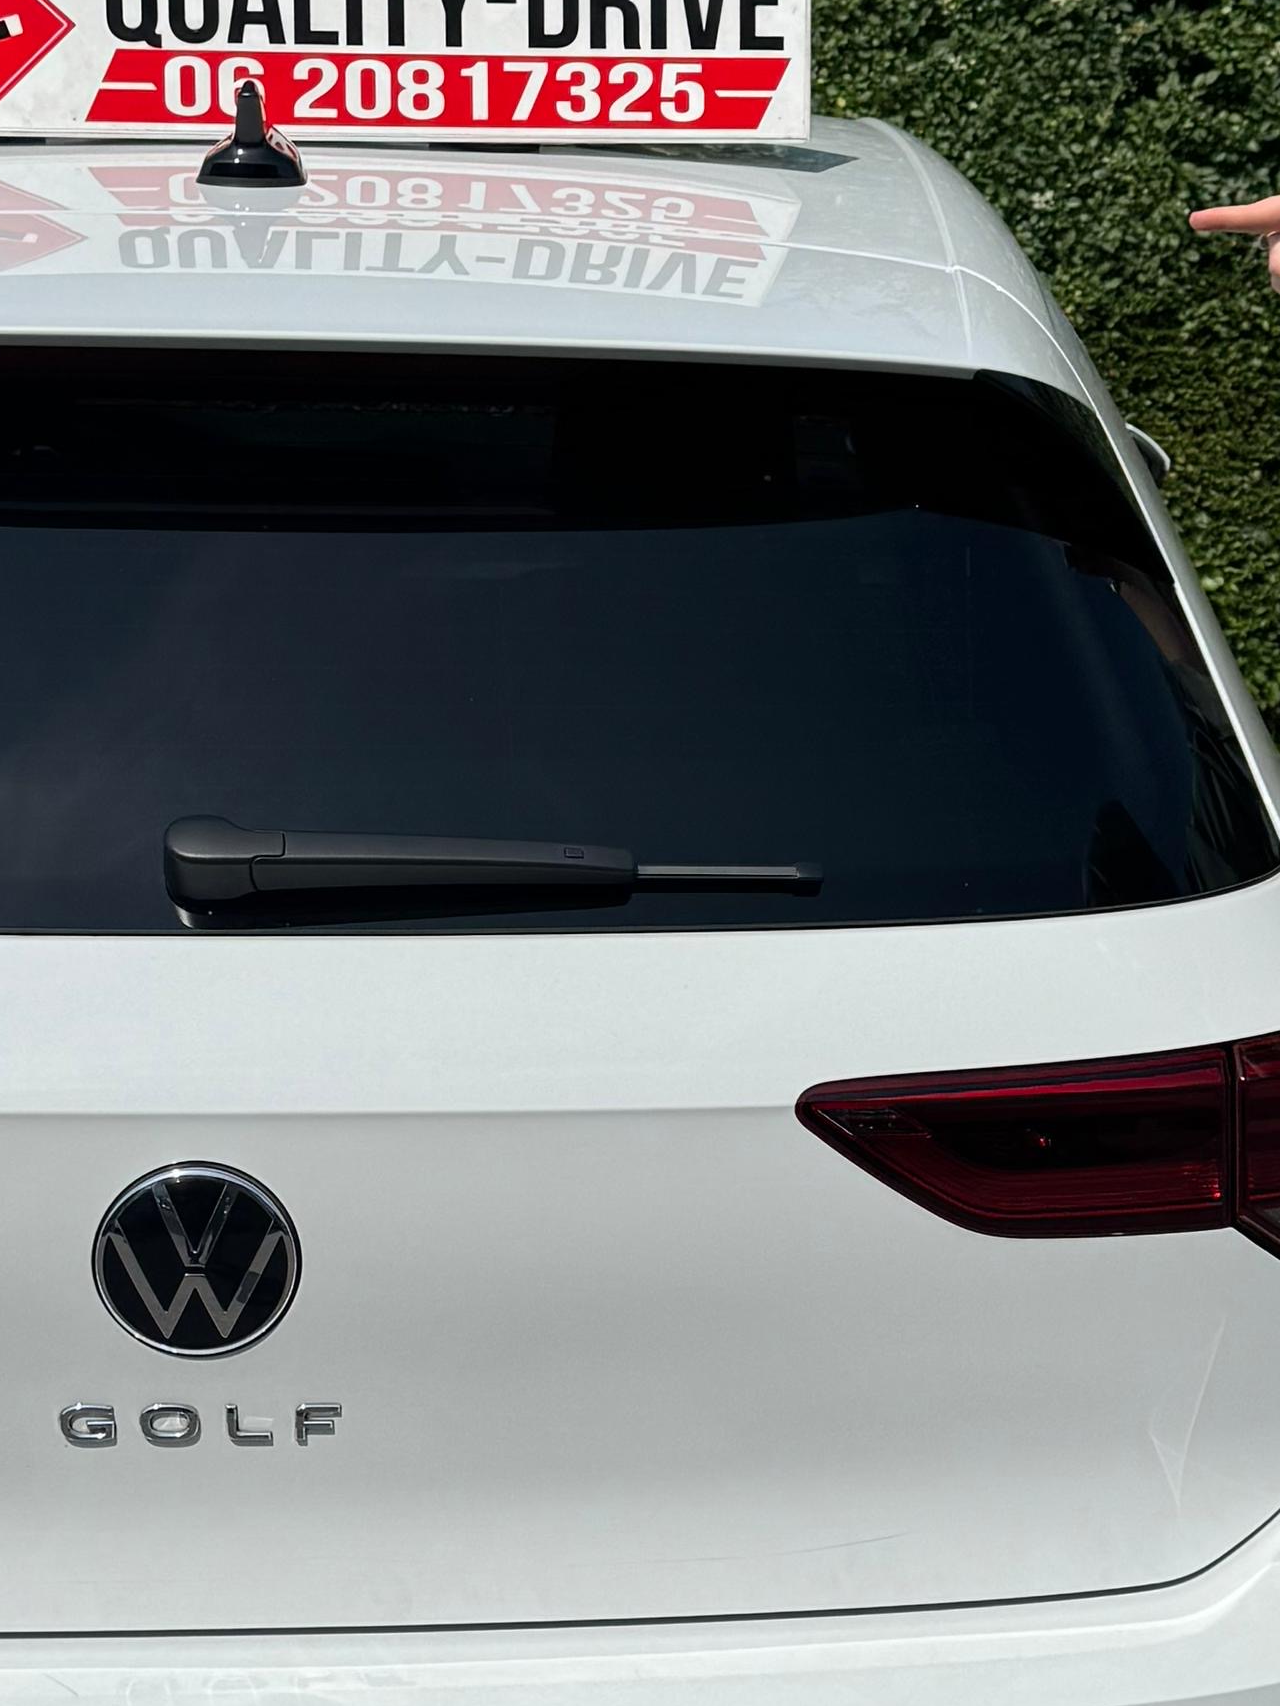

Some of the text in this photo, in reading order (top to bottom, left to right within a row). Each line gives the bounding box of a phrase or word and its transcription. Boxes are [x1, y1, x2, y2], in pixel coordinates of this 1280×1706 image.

[164, 55, 706, 123] 06 20817325
[59, 1402, 342, 1448] GOLF
